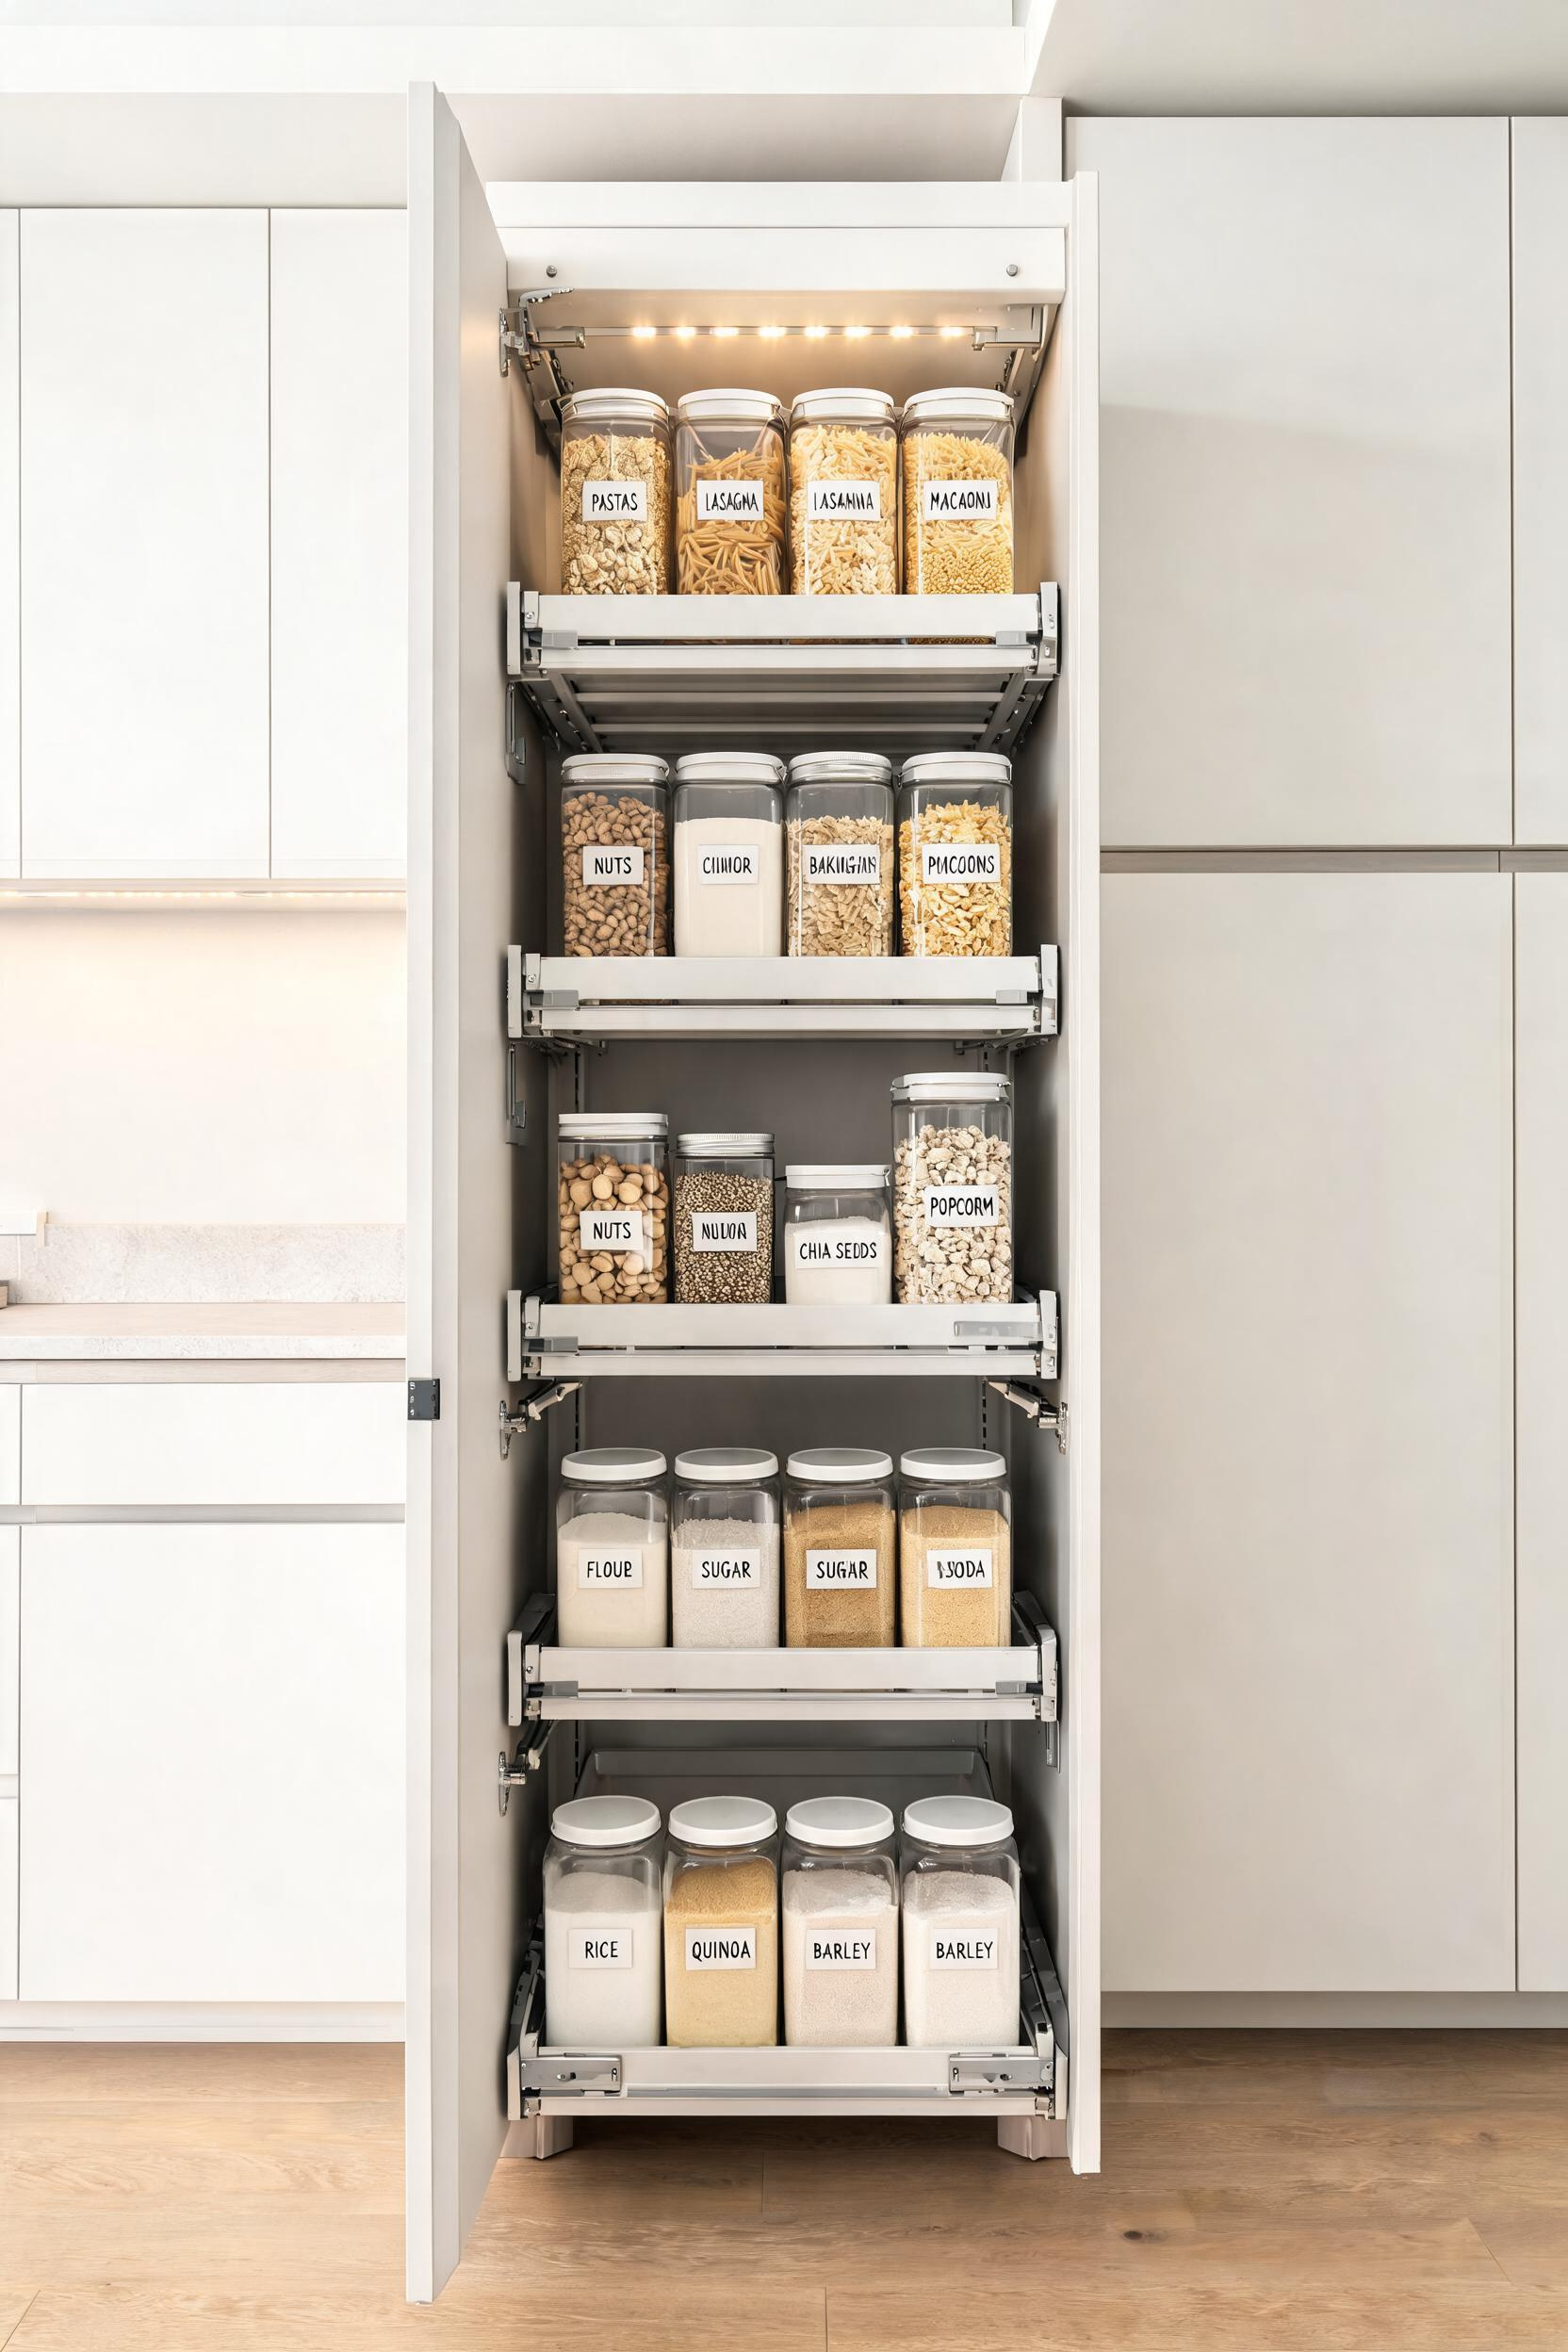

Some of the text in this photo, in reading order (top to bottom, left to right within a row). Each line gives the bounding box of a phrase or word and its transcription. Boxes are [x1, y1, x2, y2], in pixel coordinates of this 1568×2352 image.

[592, 492, 638, 513] PASTAS
[706, 492, 760, 512] LASAGNA
[595, 857, 632, 875] NUTS
[593, 1221, 631, 1240] NUTS
[799, 1242, 831, 1260] CHIA
[701, 1560, 752, 1578] SUGAR
[816, 1560, 869, 1580] SUGAR
[585, 1940, 618, 1959] RICE
[692, 1940, 751, 1963] QUINOA
[813, 1941, 871, 1960] BARLEY
[936, 1941, 993, 1960] BARLEY
